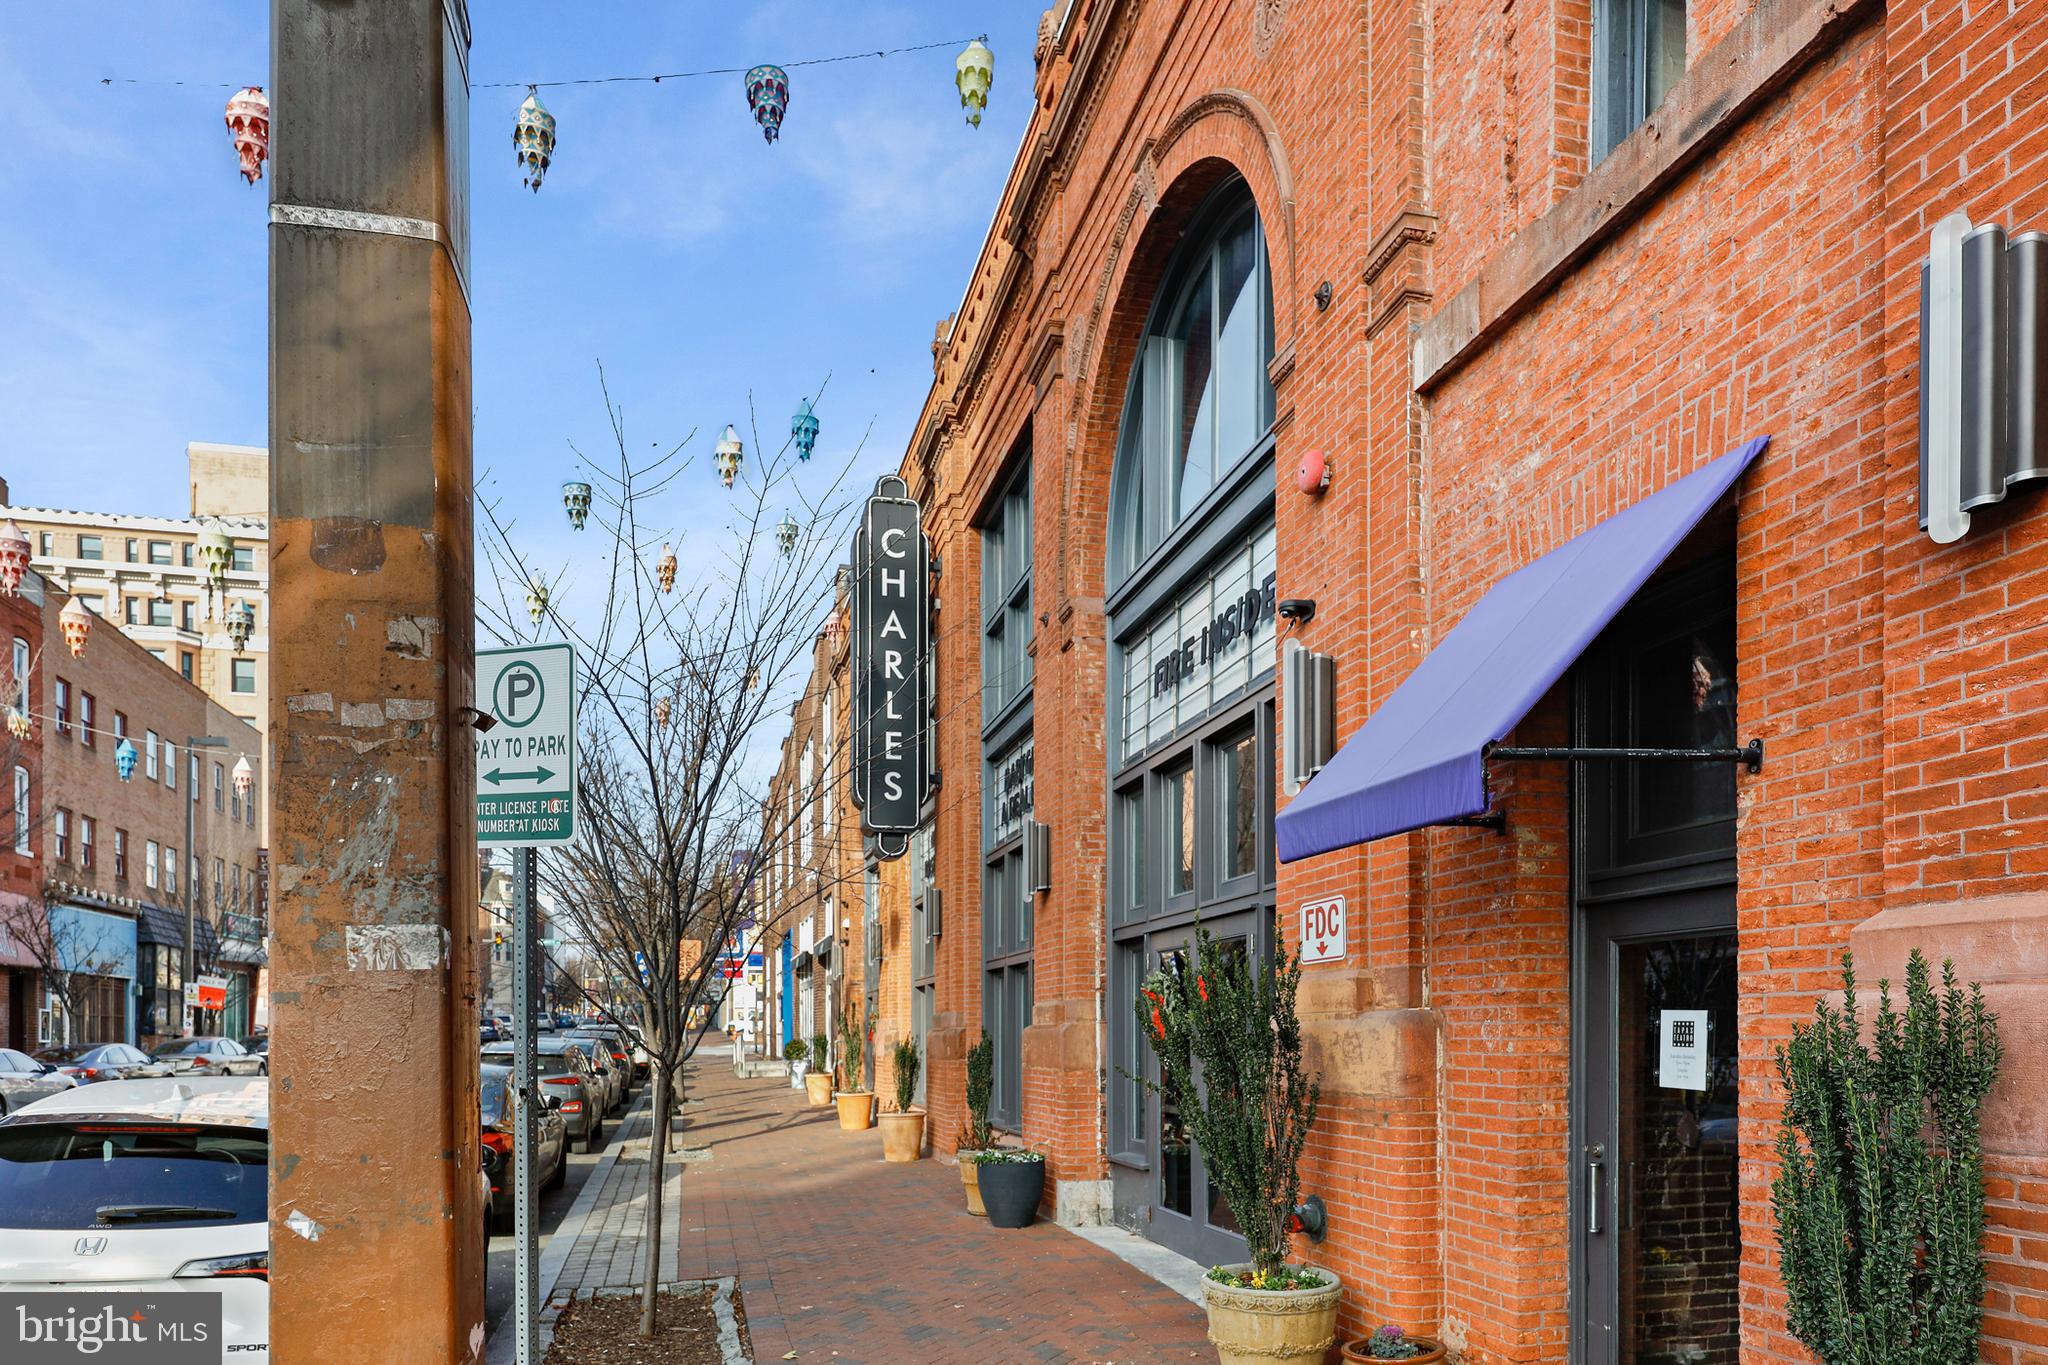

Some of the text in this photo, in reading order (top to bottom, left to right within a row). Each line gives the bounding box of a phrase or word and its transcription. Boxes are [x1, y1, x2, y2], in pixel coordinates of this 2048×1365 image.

[1153, 570, 1276, 699] FIRE INSIDE
[880, 528, 907, 801] CHARLES
[507, 672, 535, 717] P
[505, 737, 522, 758] TO
[528, 735, 566, 757] PARK
[477, 801, 496, 815] NTER
[500, 800, 537, 815] LICENSE
[477, 818, 560, 833] NUMBER AT KIOSK
[1305, 903, 1340, 941] FDC
[227, 1343, 269, 1352] SPOR
